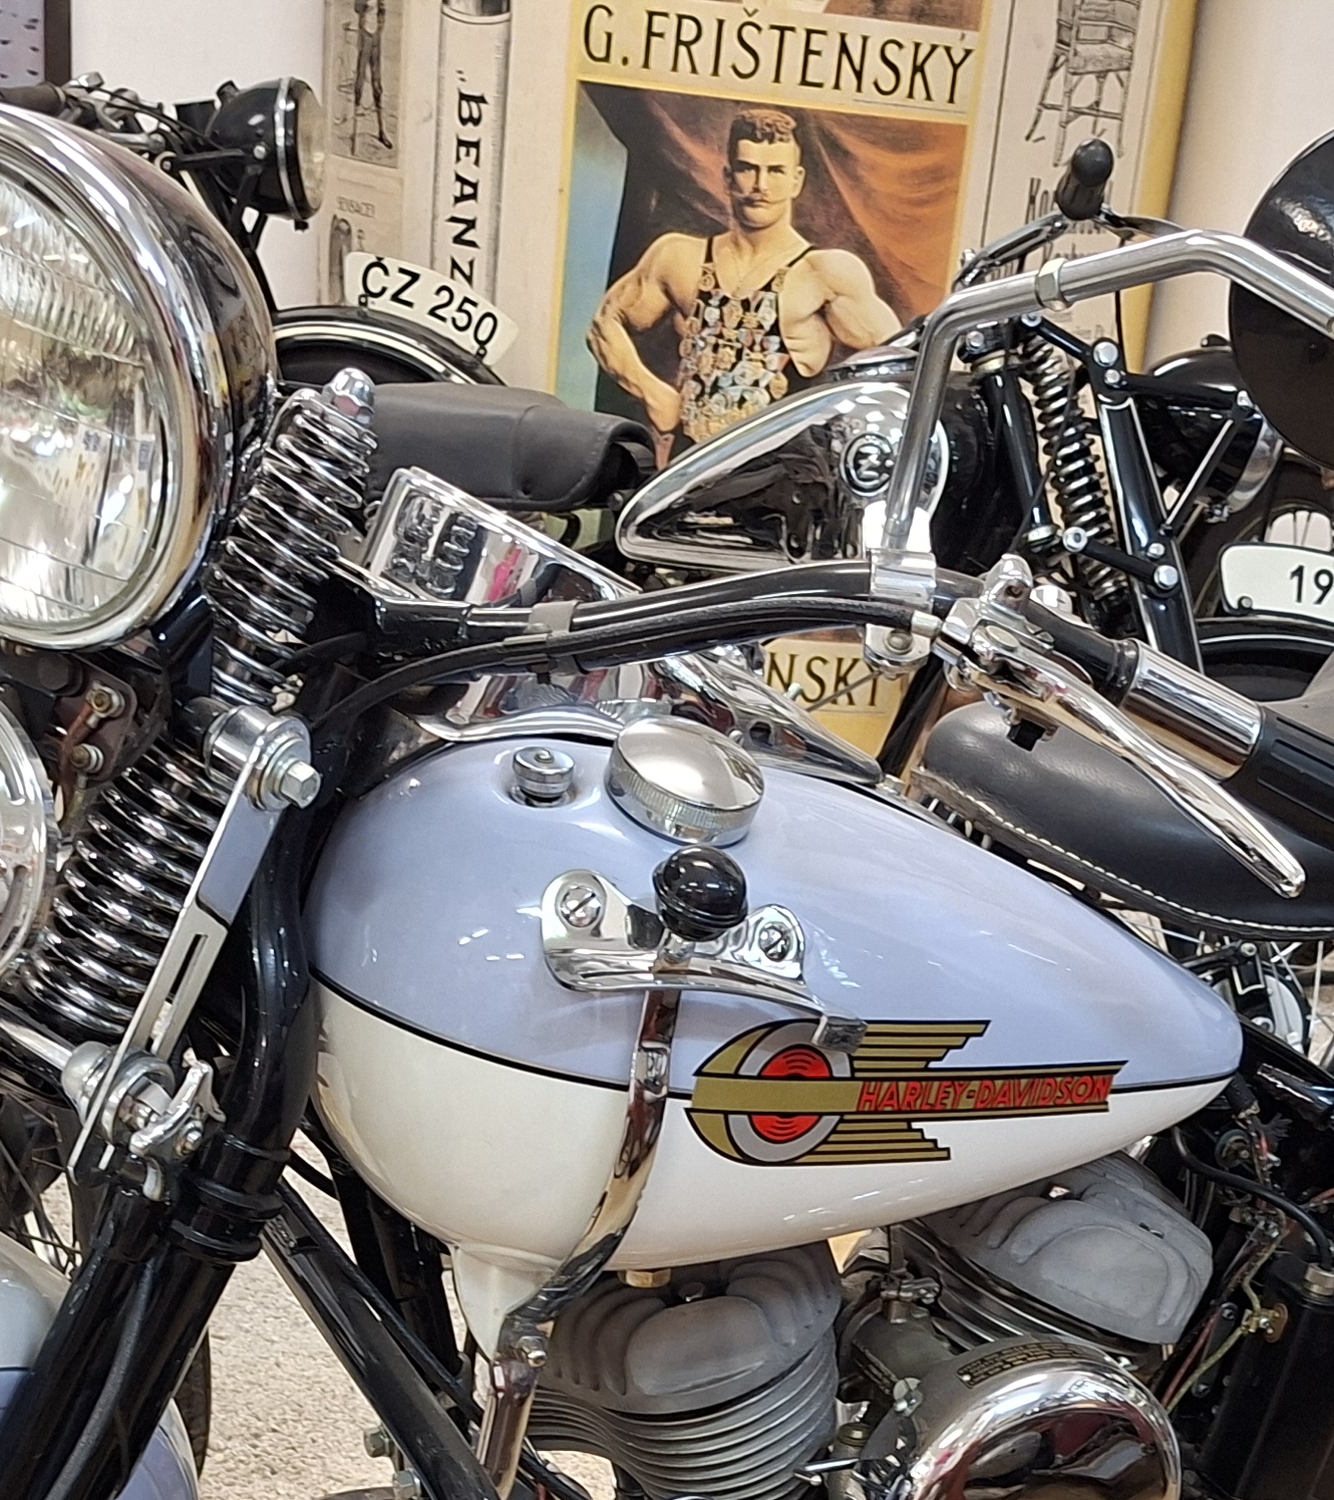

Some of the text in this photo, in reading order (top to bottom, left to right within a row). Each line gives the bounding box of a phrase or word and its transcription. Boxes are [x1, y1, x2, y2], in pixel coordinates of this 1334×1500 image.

[583, 4, 974, 105] G. FRIŠTENSKÝ
[361, 256, 499, 347] ČZ 250
[857, 1073, 1113, 1113] HARLEY-DAVIDSON
